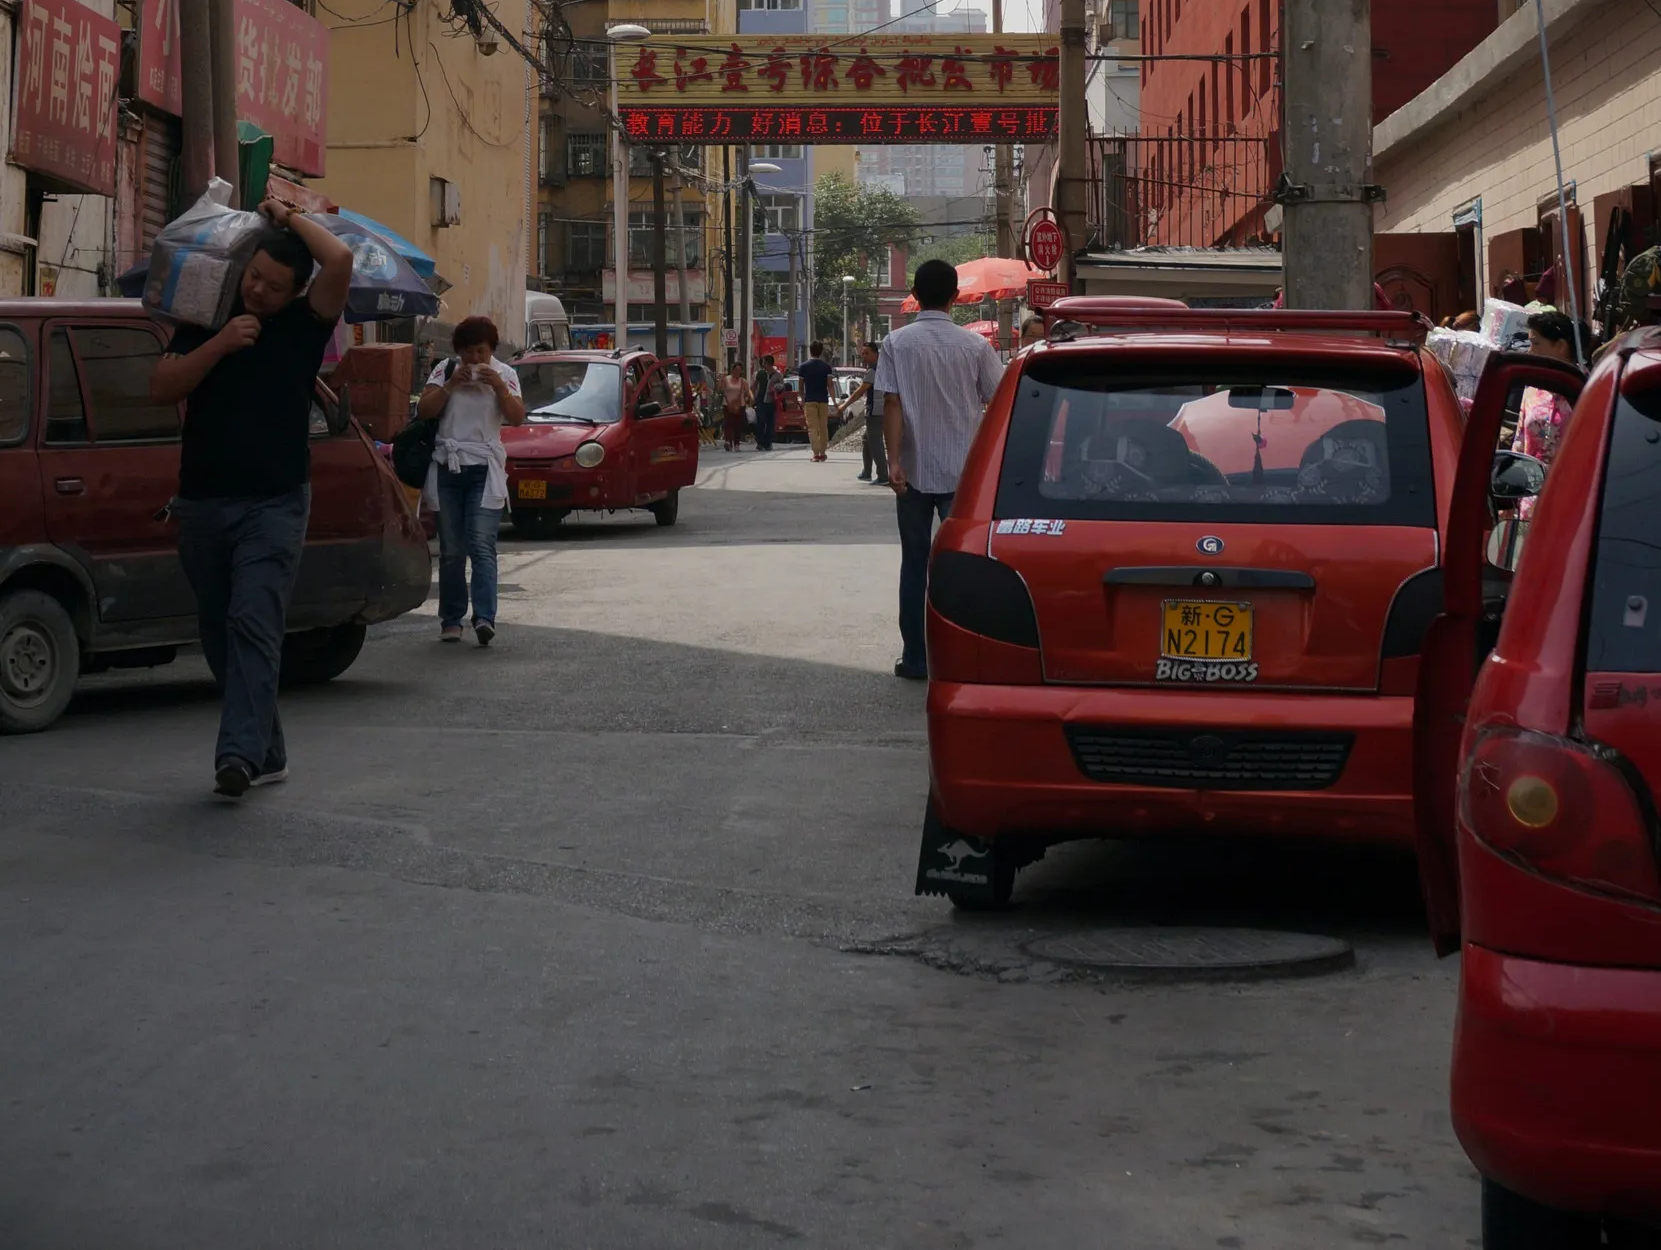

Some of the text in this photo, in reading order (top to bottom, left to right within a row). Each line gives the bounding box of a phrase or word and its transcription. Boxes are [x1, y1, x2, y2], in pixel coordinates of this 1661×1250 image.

[626, 111, 732, 136] 教育能力
[1167, 628, 1246, 657] N2174
[1155, 659, 1258, 682] BIG BOSS
